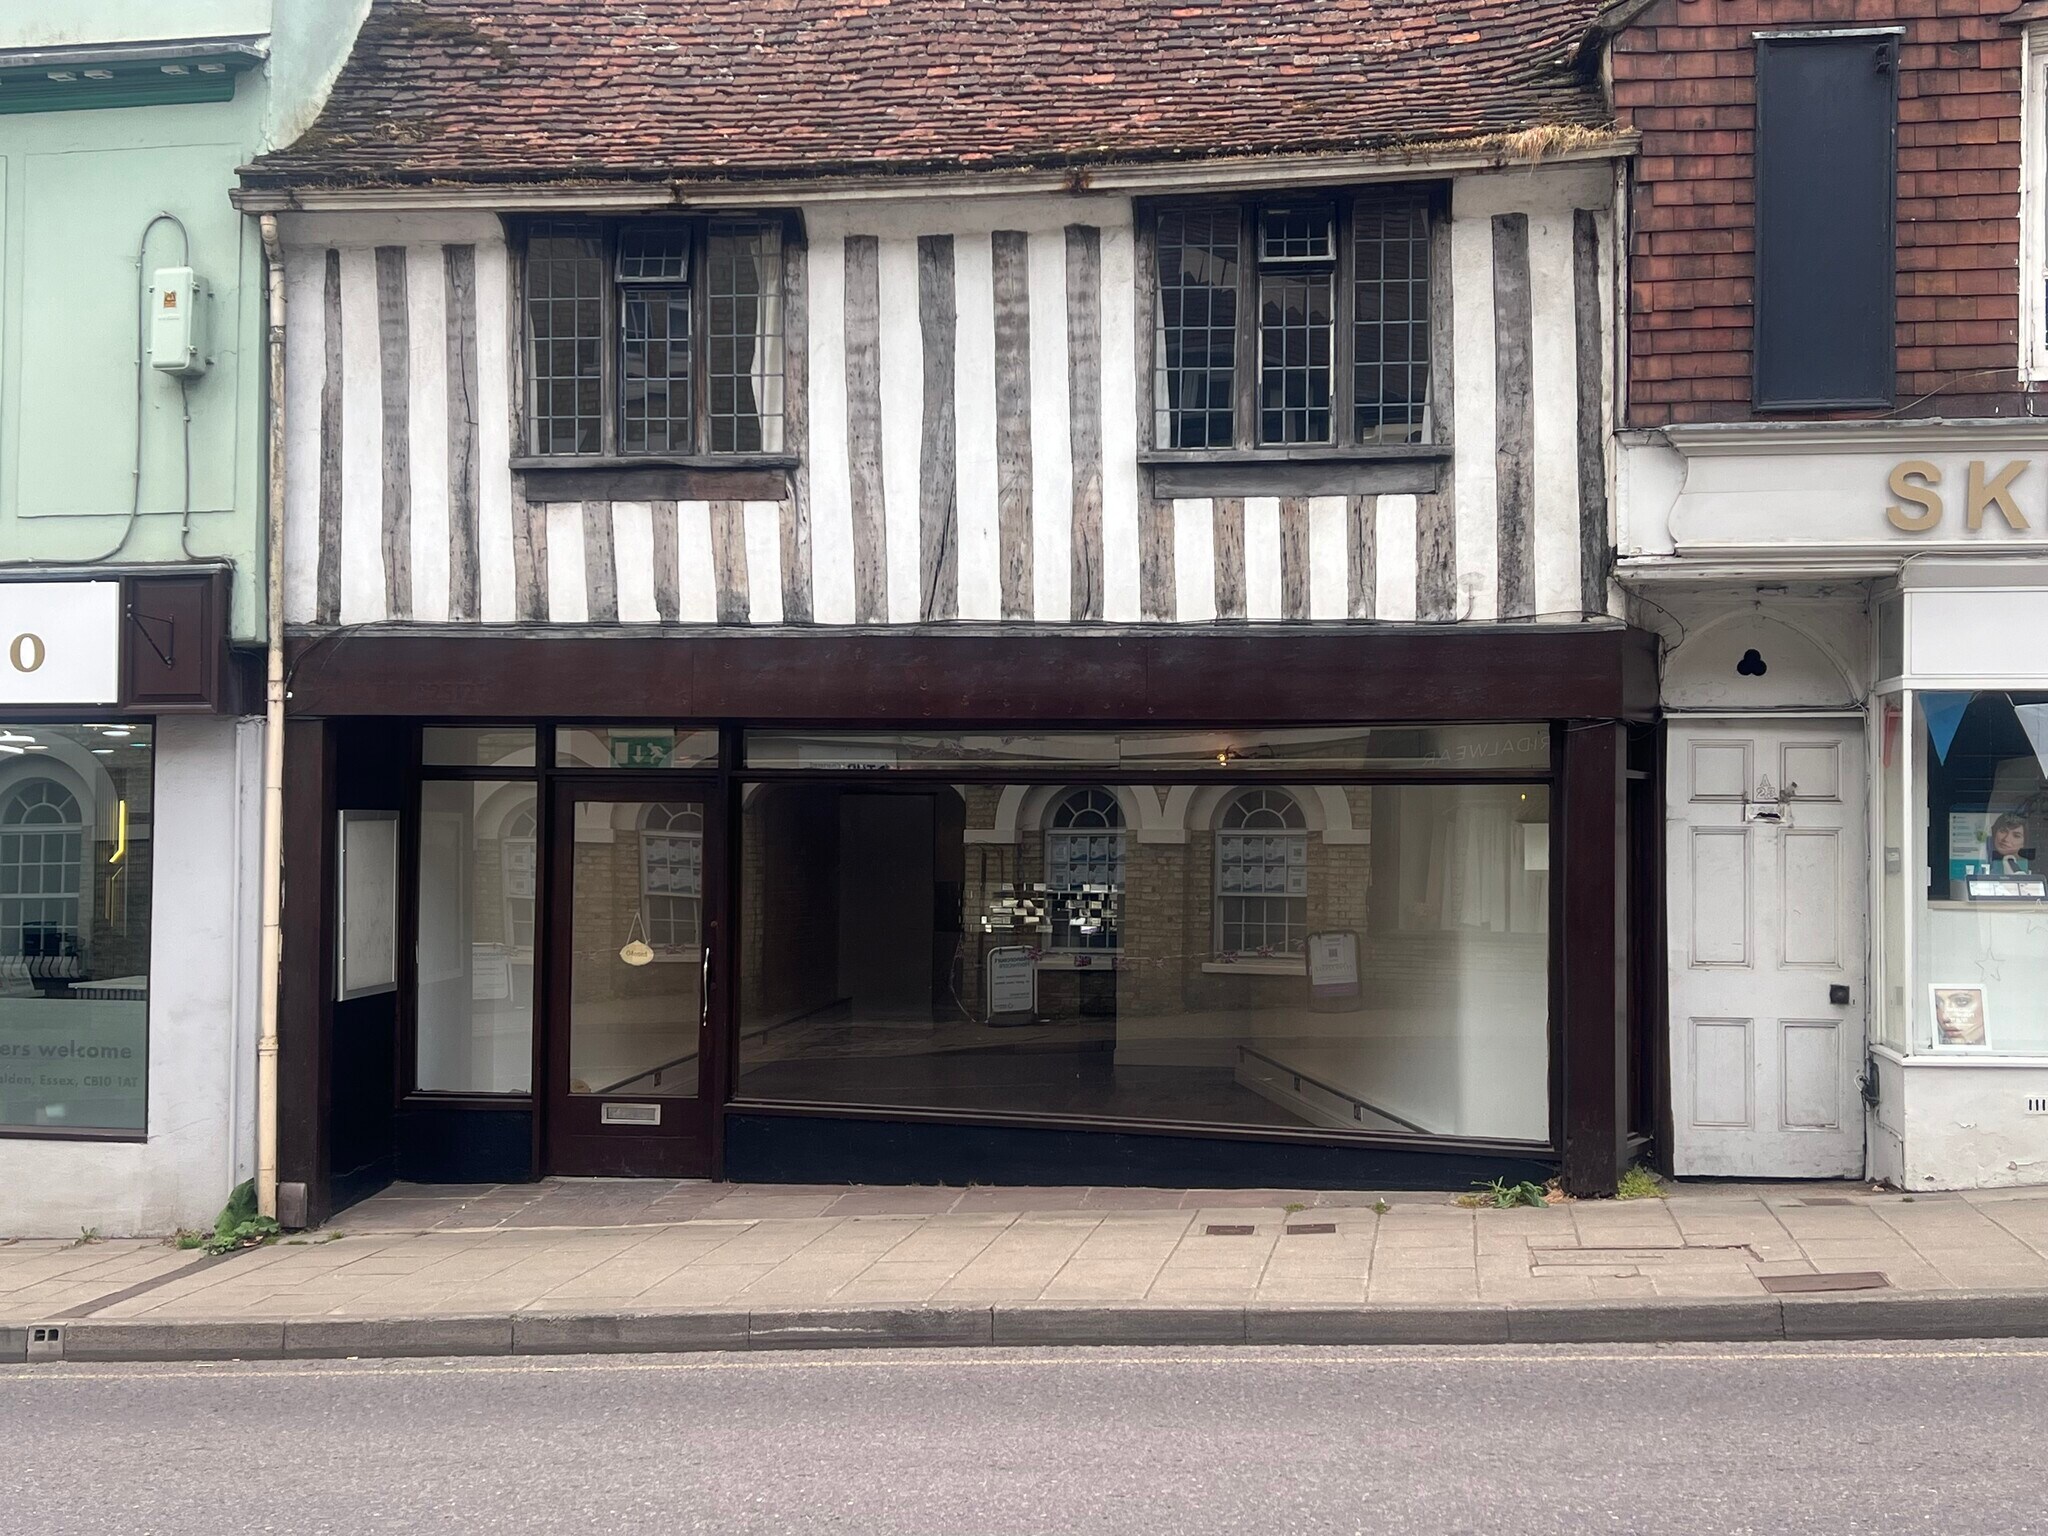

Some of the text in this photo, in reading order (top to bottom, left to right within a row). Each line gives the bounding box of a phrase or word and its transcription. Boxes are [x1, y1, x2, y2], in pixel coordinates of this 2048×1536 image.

[38, 1040, 132, 1059] welcome
[40, 1075, 79, 1088] Essex,
[83, 1076, 112, 1087] CB10
[118, 1077, 138, 1088] 1AT
